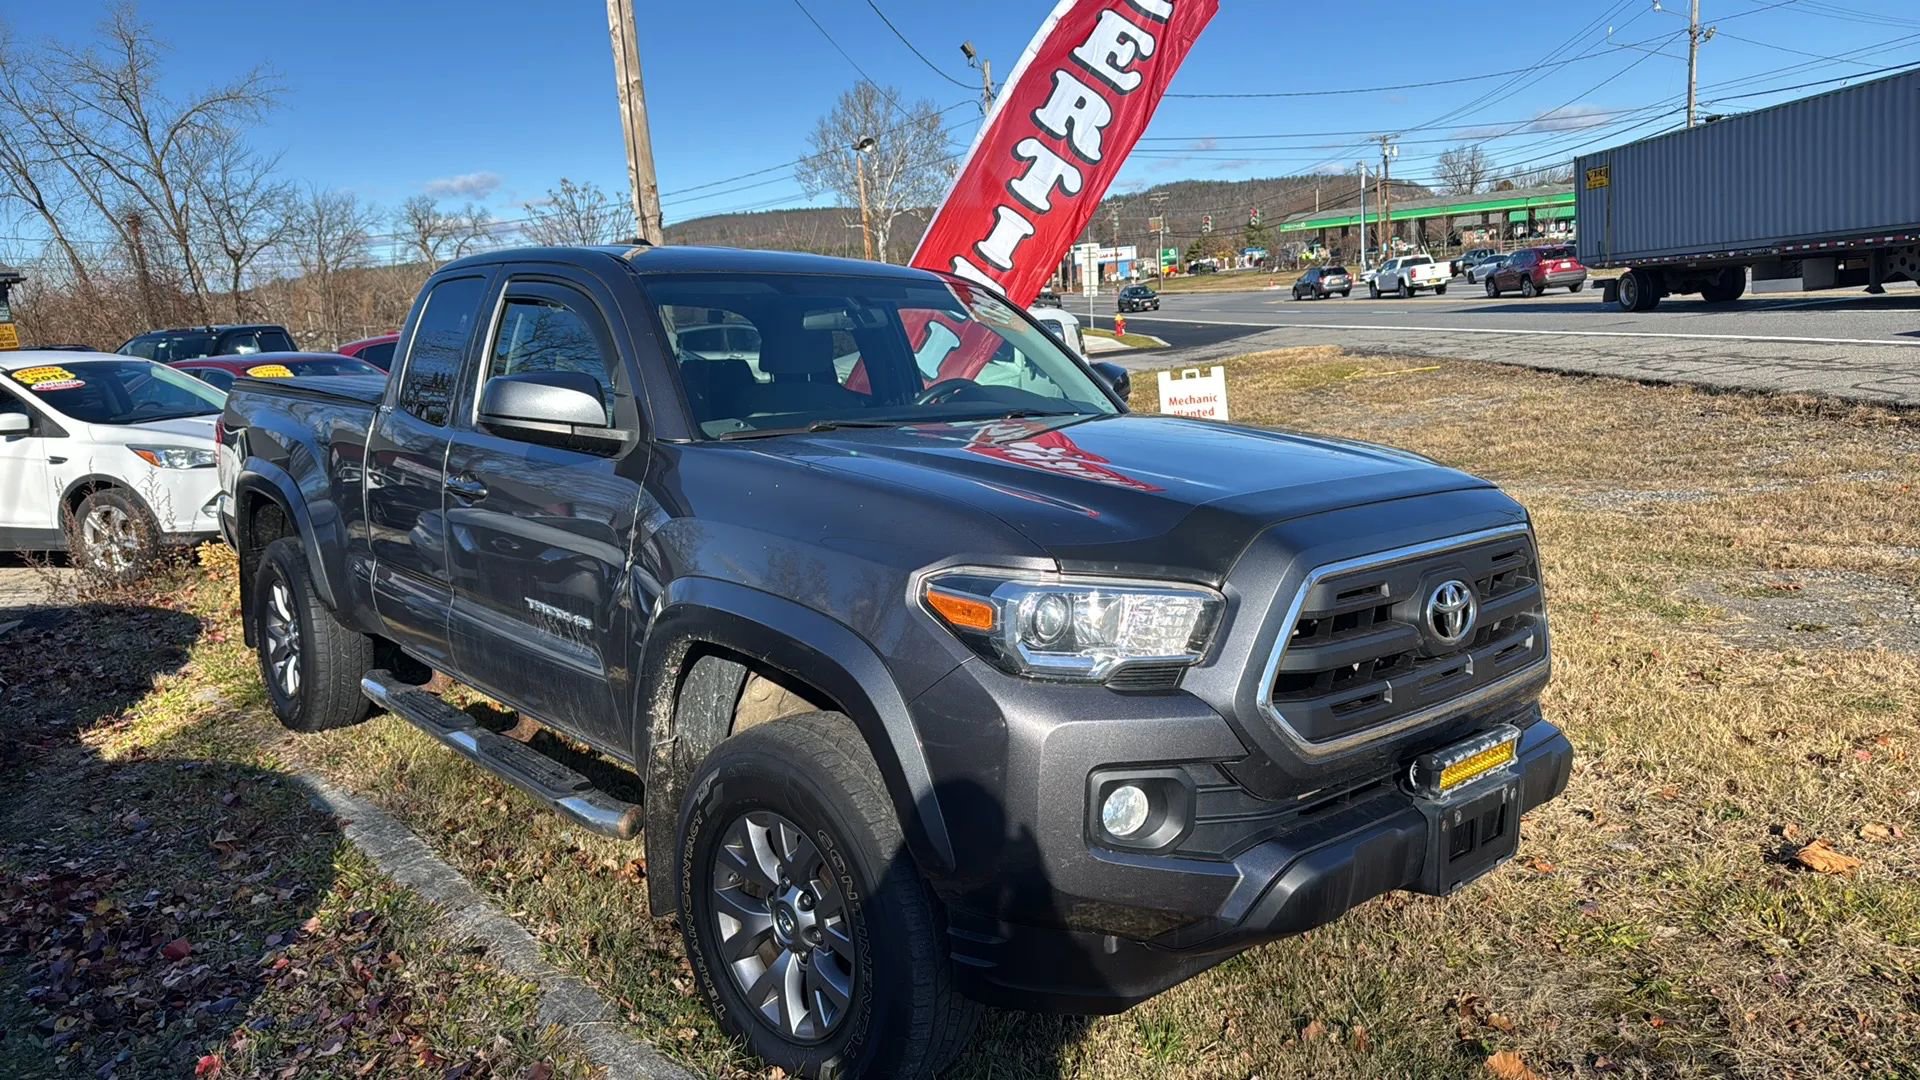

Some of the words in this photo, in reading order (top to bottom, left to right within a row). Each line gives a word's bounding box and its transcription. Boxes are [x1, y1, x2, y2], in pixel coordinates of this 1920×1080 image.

[31, 373, 69, 382] 2015
[1169, 394, 1218, 406] Mechanic
[1174, 406, 1215, 418] Wanted
[817, 829, 873, 1058] CONTINENTAL
